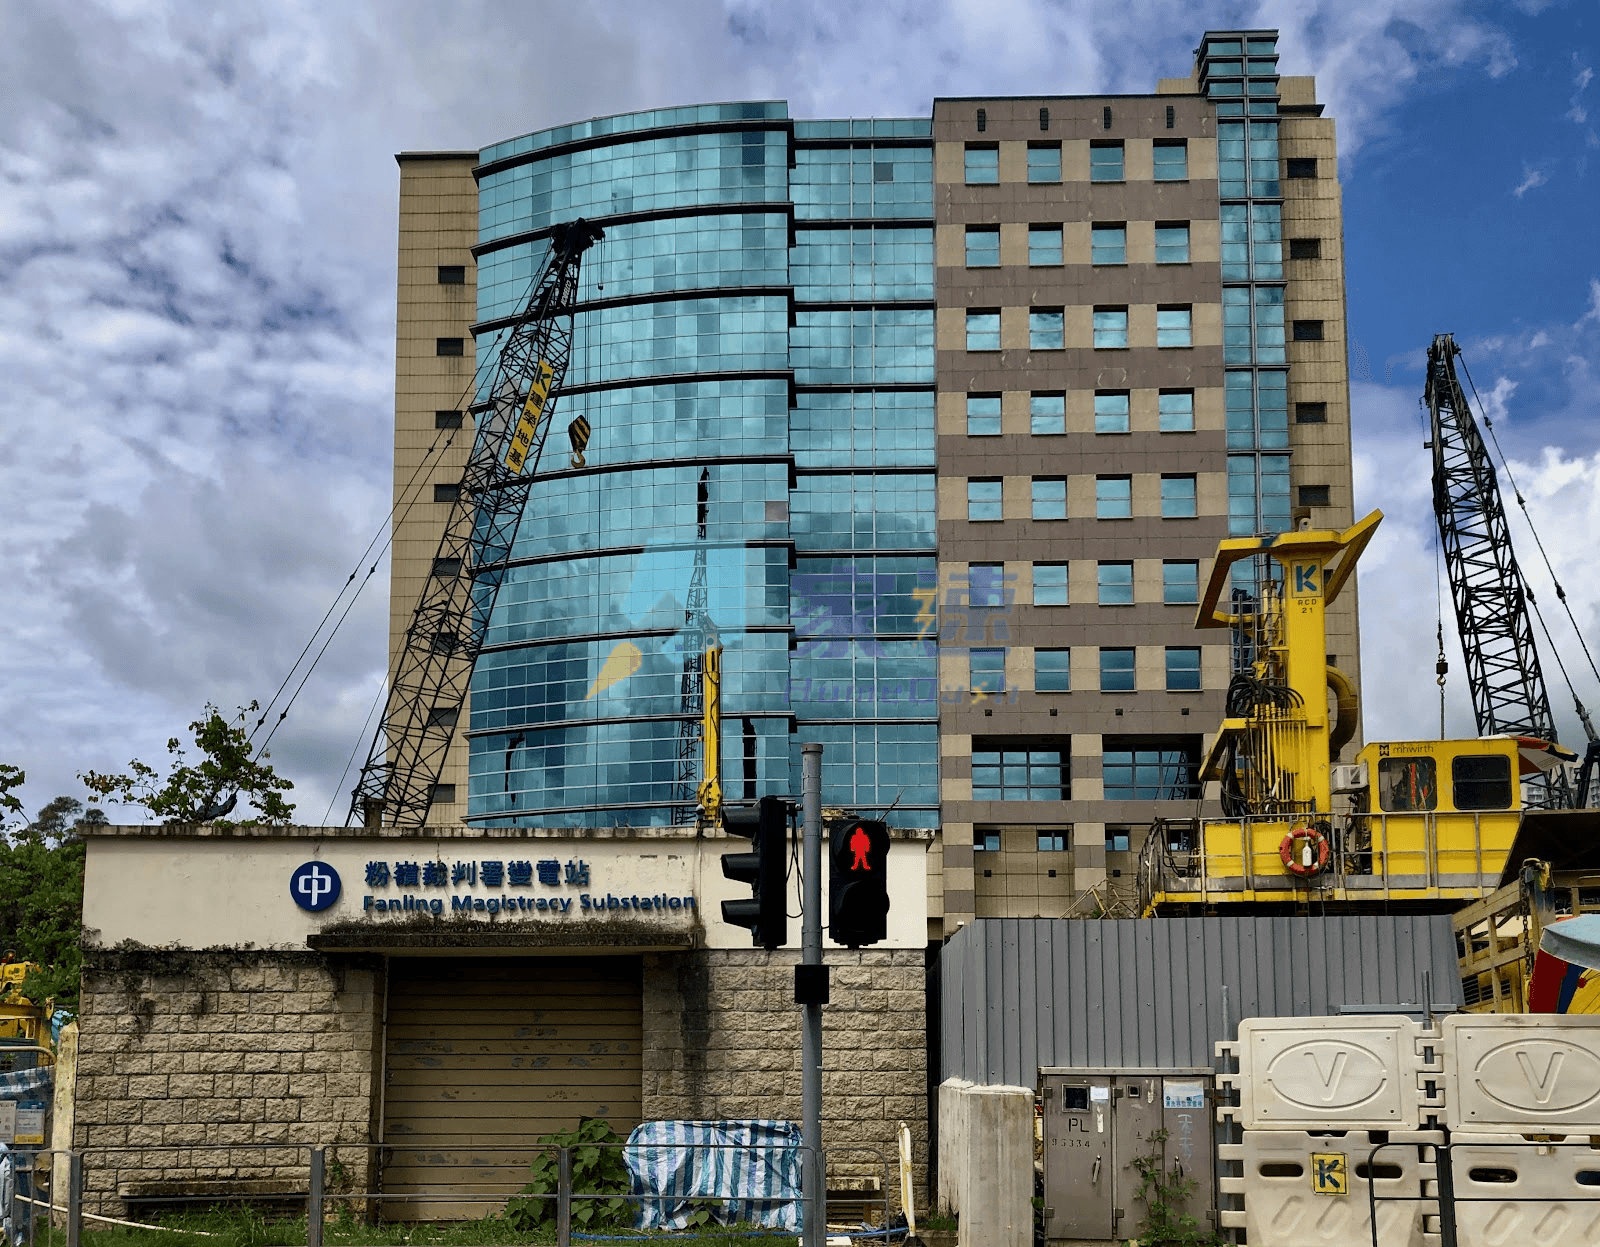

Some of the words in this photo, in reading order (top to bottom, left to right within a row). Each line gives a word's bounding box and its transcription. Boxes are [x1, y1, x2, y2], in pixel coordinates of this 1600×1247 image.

[535, 365, 552, 393] K
[1296, 564, 1317, 592] K
[1297, 598, 1317, 606] RCD
[1392, 744, 1434, 754] mhwirth
[364, 859, 590, 888] 粉嶺裁判署變電站
[363, 894, 443, 915] Fanling
[451, 893, 572, 915] Magistracy
[580, 892, 697, 911] Substation
[1068, 1117, 1090, 1133] PL
[1318, 1159, 1341, 1189] K
